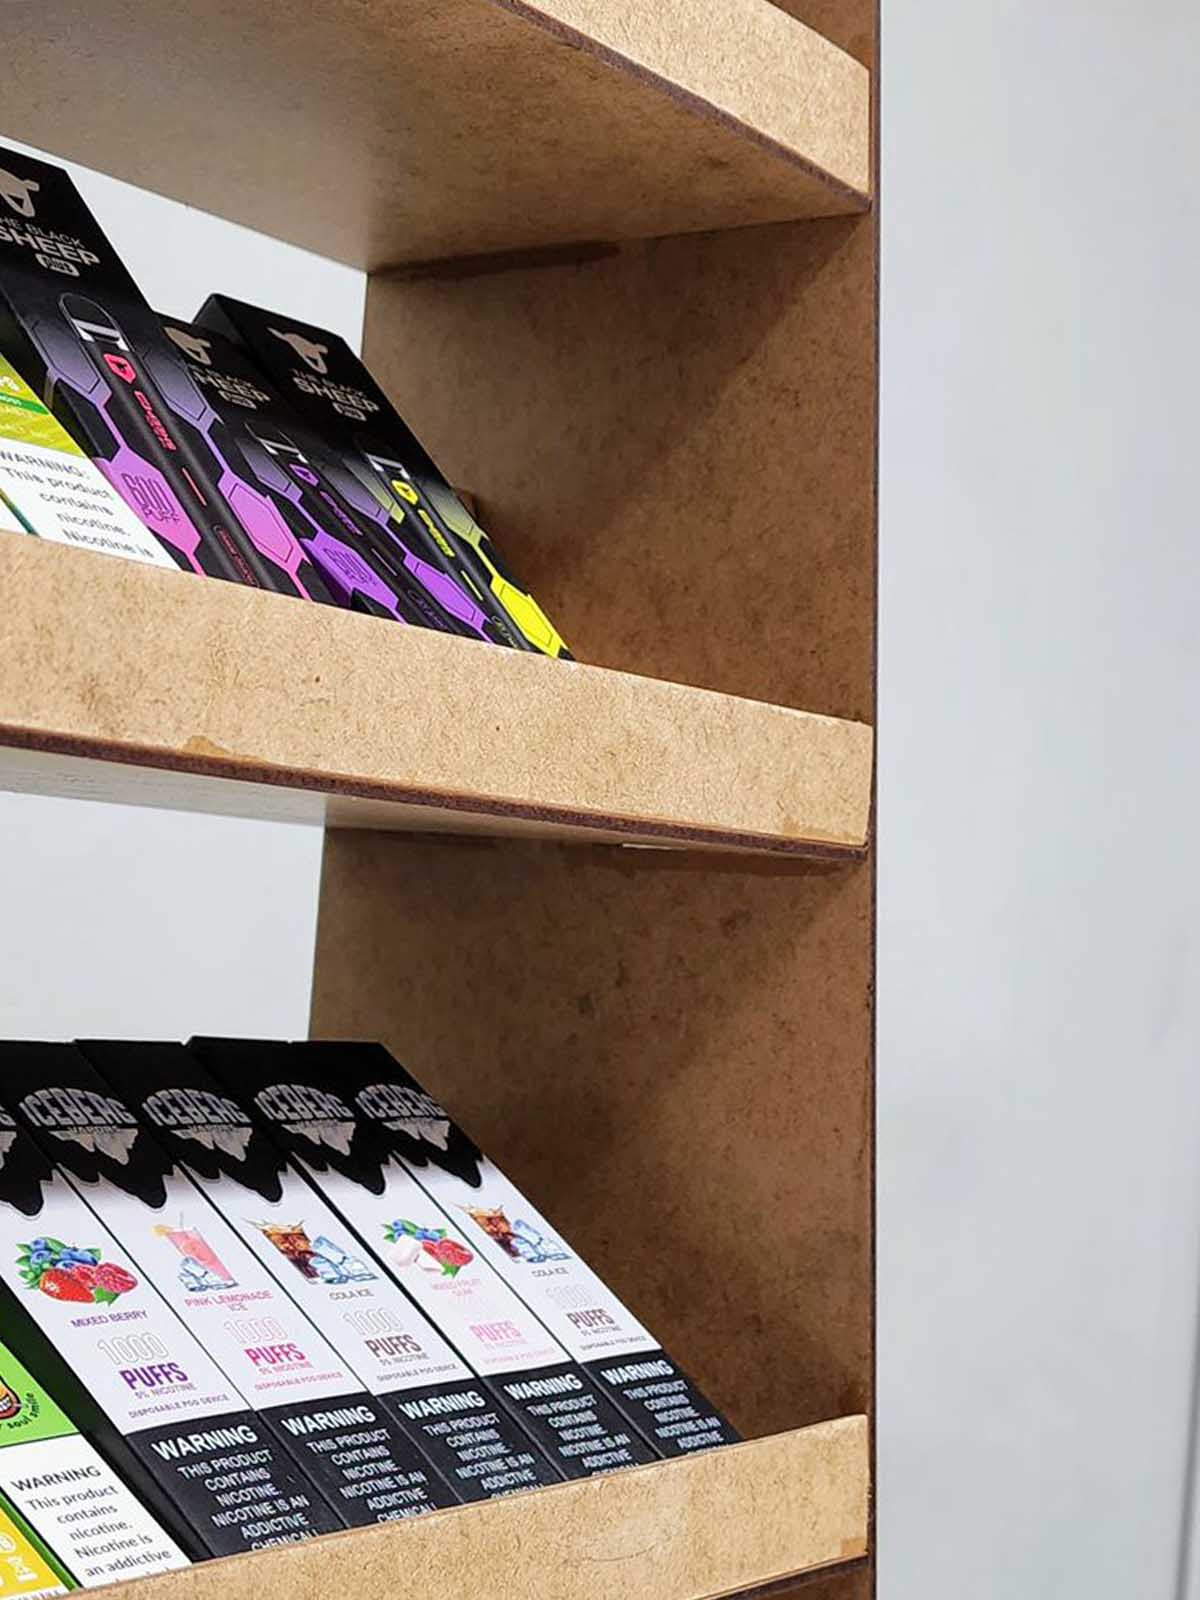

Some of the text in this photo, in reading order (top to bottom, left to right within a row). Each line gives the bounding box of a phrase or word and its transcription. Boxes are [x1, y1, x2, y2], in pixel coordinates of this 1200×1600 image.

[0, 225, 100, 265] SHEEP
[192, 371, 271, 402] HEEP
[39, 492, 114, 516] contains
[19, 1087, 139, 1127] ICEBERG
[141, 1088, 252, 1126] ICEBERG
[254, 1084, 354, 1121] ICEBERG
[214, 1290, 273, 1305] LEMONADE
[70, 1310, 148, 1328] MIXED BERRY
[223, 1316, 288, 1344] 1000
[566, 1308, 615, 1329] PUFFS
[97, 1332, 169, 1366] 1000
[243, 1342, 305, 1367] PUFFS
[364, 1333, 423, 1358] PUFFS
[119, 1362, 189, 1390] PUFFS
[601, 1360, 674, 1385] WARNING
[503, 1373, 584, 1400] WARNING
[399, 1390, 486, 1420] WARNING
[281, 1406, 376, 1436] WARNING
[422, 1413, 500, 1437] THIS PRODUCT
[151, 1425, 258, 1461] WARNING
[306, 1428, 391, 1454] THIS PRODUCT
[446, 1428, 500, 1448] CONTAINS
[177, 1449, 273, 1480] THIS PRODUCT
[331, 1445, 390, 1466] CONTAINS
[457, 1442, 511, 1462] NICOTINE.
[10, 1465, 101, 1492] WARNING
[204, 1467, 271, 1492] CONTAINS
[342, 1460, 400, 1481] NICOTINE.
[455, 1453, 535, 1480] NICOTINE IS AN
[480, 1468, 536, 1491] ADDICTIVE
[26, 1485, 119, 1511] This product
[215, 1483, 282, 1508] NICOTINE.
[339, 1471, 427, 1500] NICOTINE IS AN
[211, 1494, 310, 1528] NICOTINE IS AN
[366, 1487, 427, 1511] ADDICTIVE
[57, 1503, 118, 1525] contains
[240, 1513, 310, 1540] ADDICTIVE
[69, 1520, 133, 1541] nicotine.
[74, 1534, 152, 1559] Nicotine is
[86, 1549, 172, 1577] an addictive
